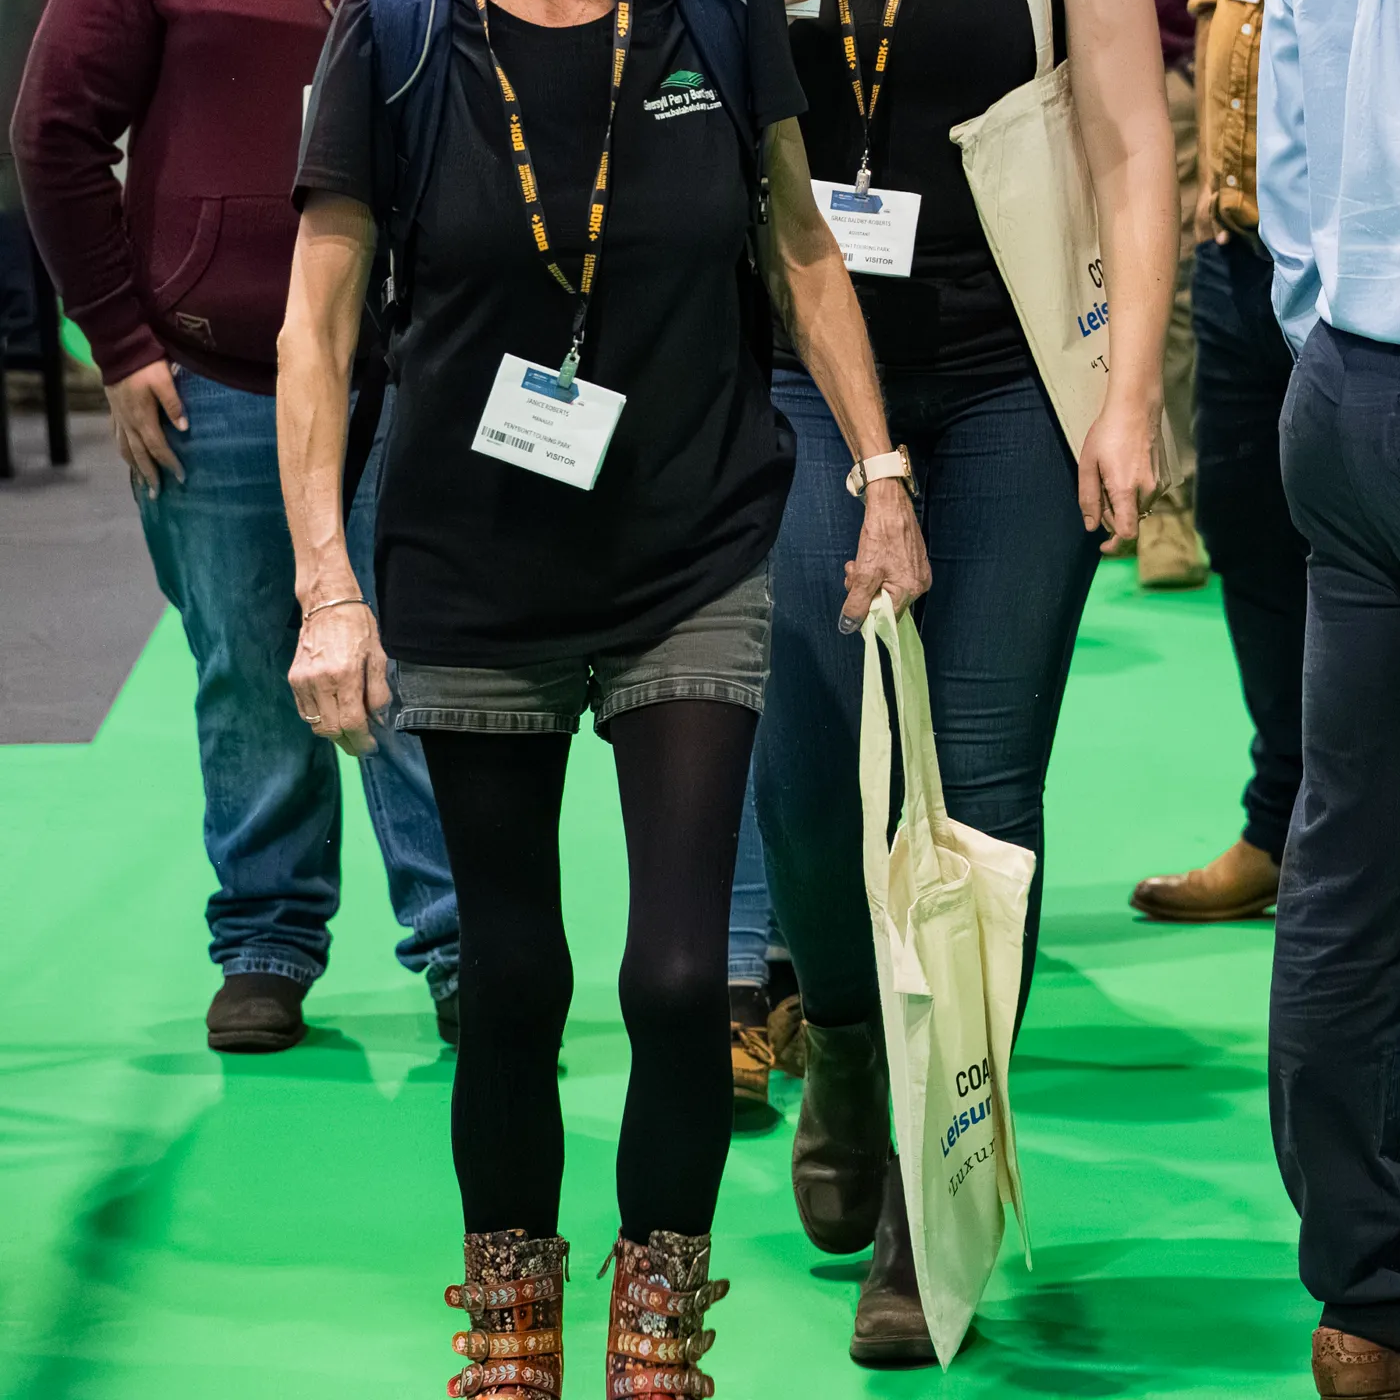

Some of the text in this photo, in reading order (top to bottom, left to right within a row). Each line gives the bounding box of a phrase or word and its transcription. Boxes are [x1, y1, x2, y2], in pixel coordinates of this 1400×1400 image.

[616, 1, 630, 39] BOX+
[843, 35, 857, 71] BOX+
[875, 37, 889, 72] BOX+
[509, 113, 526, 152] BOX+
[531, 213, 549, 252] BOX+
[588, 203, 605, 242] BOX+
[864, 256, 894, 265] VISITOR
[1077, 302, 1110, 338] Leis
[545, 450, 576, 468] VISITOR
[955, 1057, 993, 1098] COA
[940, 1094, 993, 1159] Leisur
